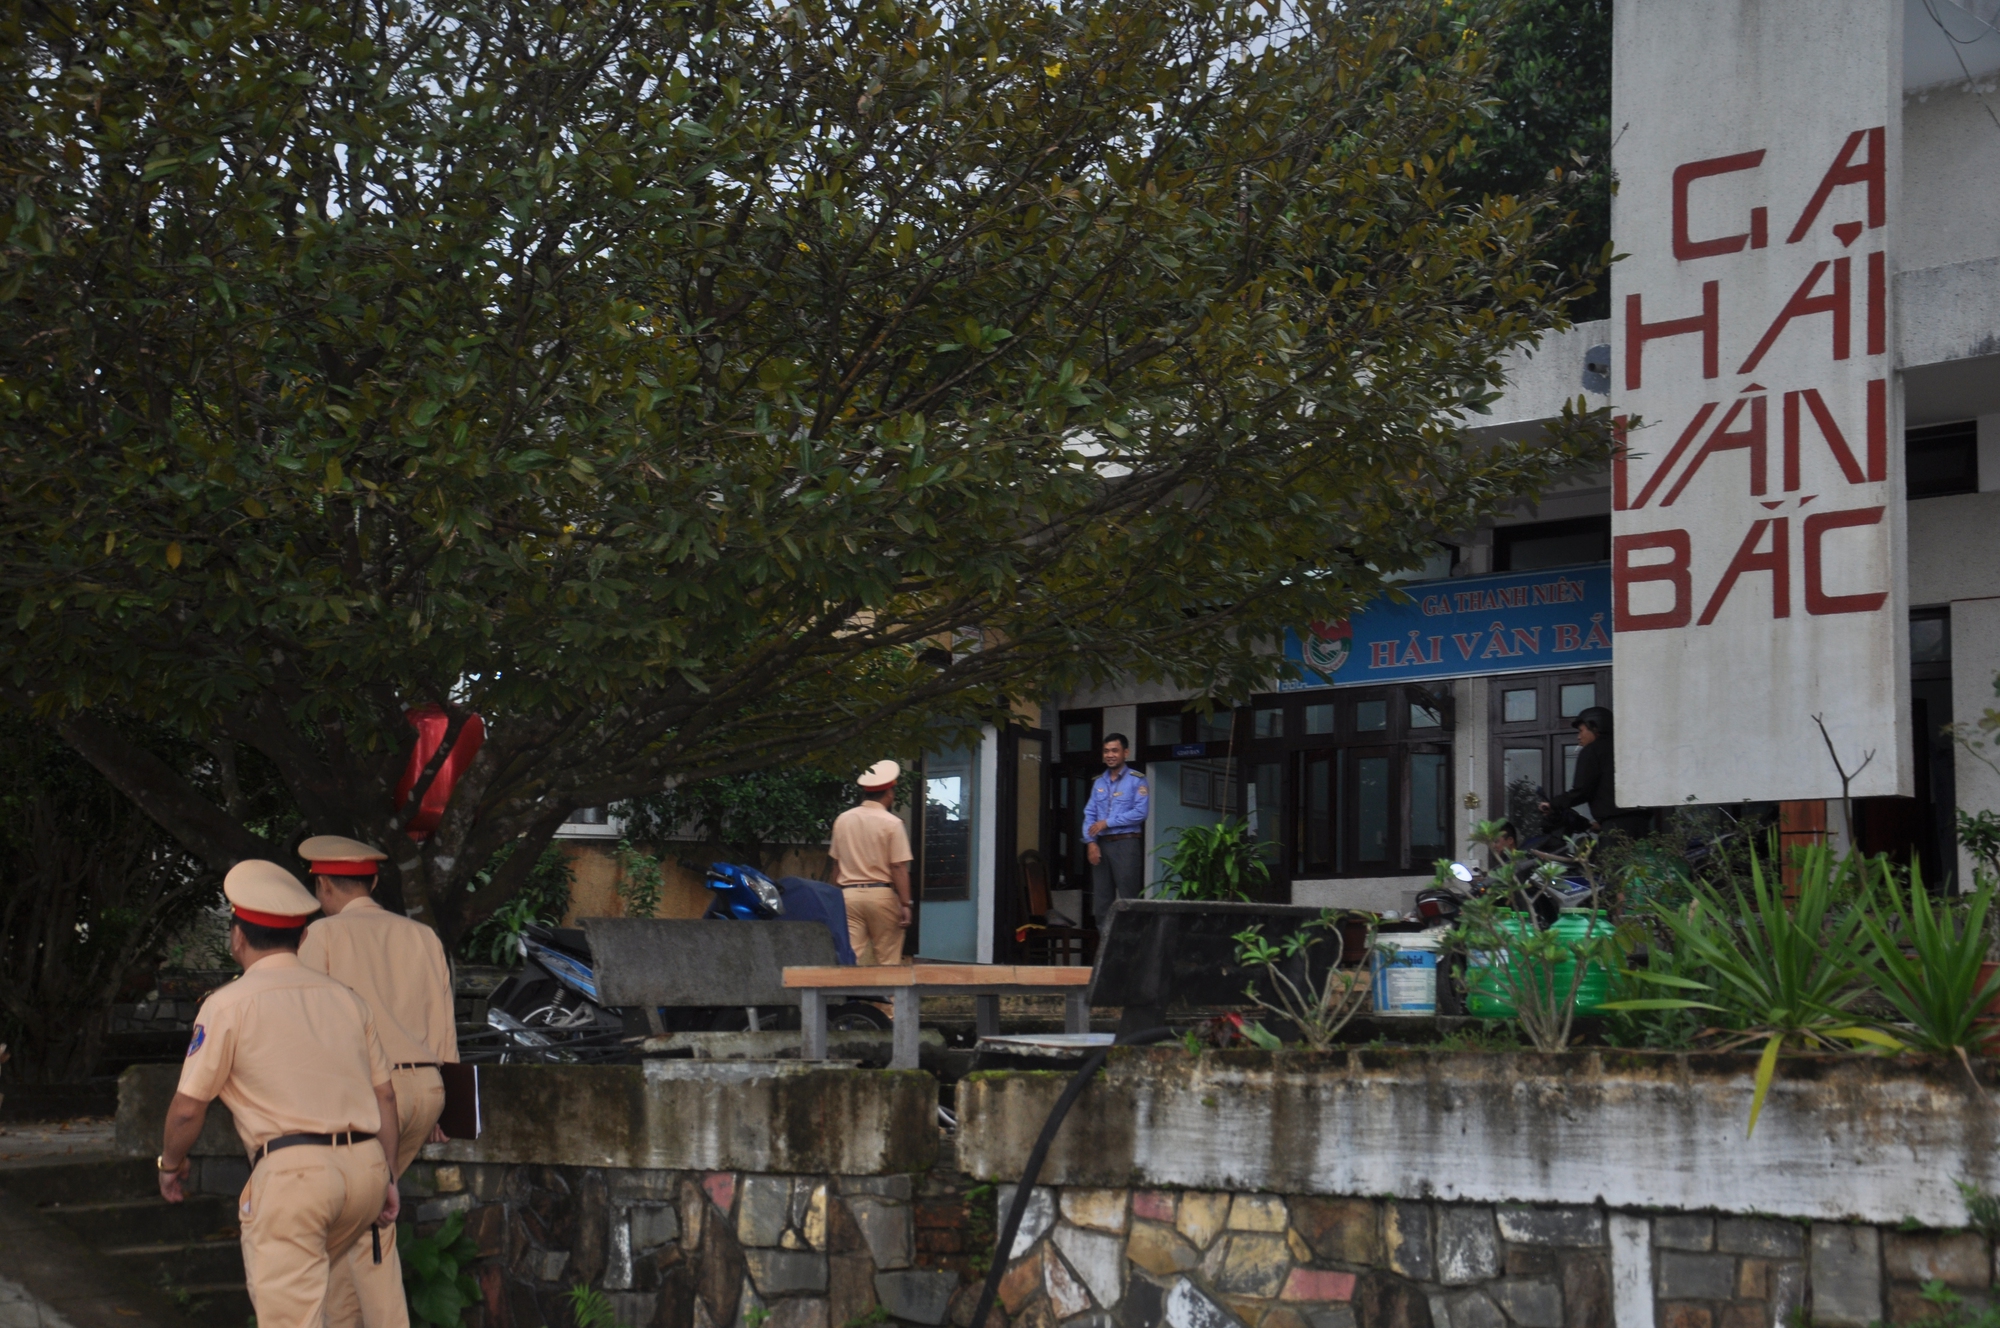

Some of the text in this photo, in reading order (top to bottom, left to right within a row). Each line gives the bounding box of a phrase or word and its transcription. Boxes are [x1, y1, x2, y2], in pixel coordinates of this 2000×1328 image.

[1672, 126, 1886, 261] GA
[1613, 376, 1887, 511] VÂN
[1422, 577, 1585, 617] GA THANH NIÊN
[1613, 494, 1889, 633] BẮC
[1368, 630, 1444, 669] HẢI
[1451, 621, 1543, 661] VÂN
[1552, 612, 1613, 653] BẮ
